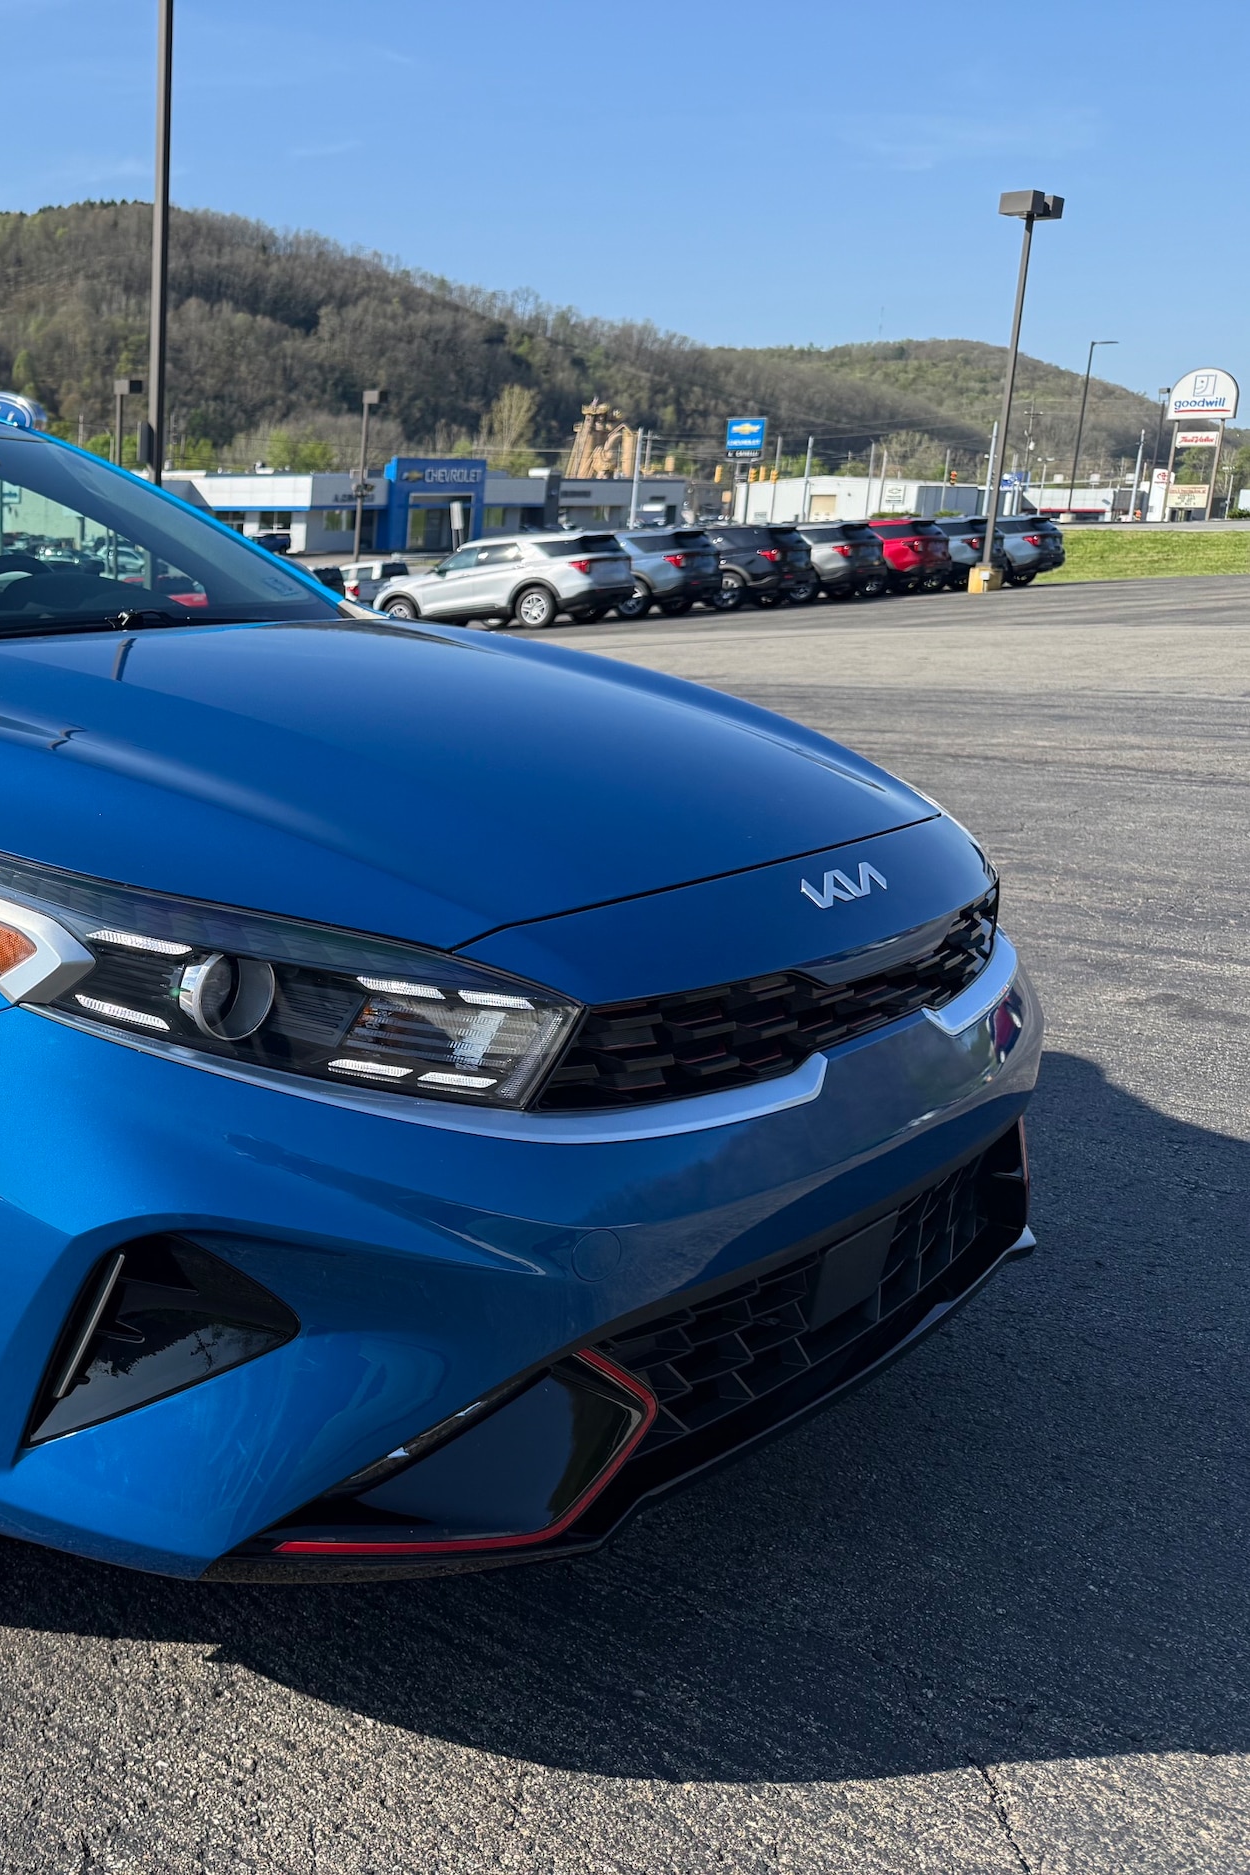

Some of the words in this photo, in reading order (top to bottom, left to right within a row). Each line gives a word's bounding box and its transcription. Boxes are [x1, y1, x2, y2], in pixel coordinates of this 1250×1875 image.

[1174, 397, 1226, 410] goodwill
[424, 467, 483, 484] CHEVROLET
[800, 861, 888, 910] KIA
